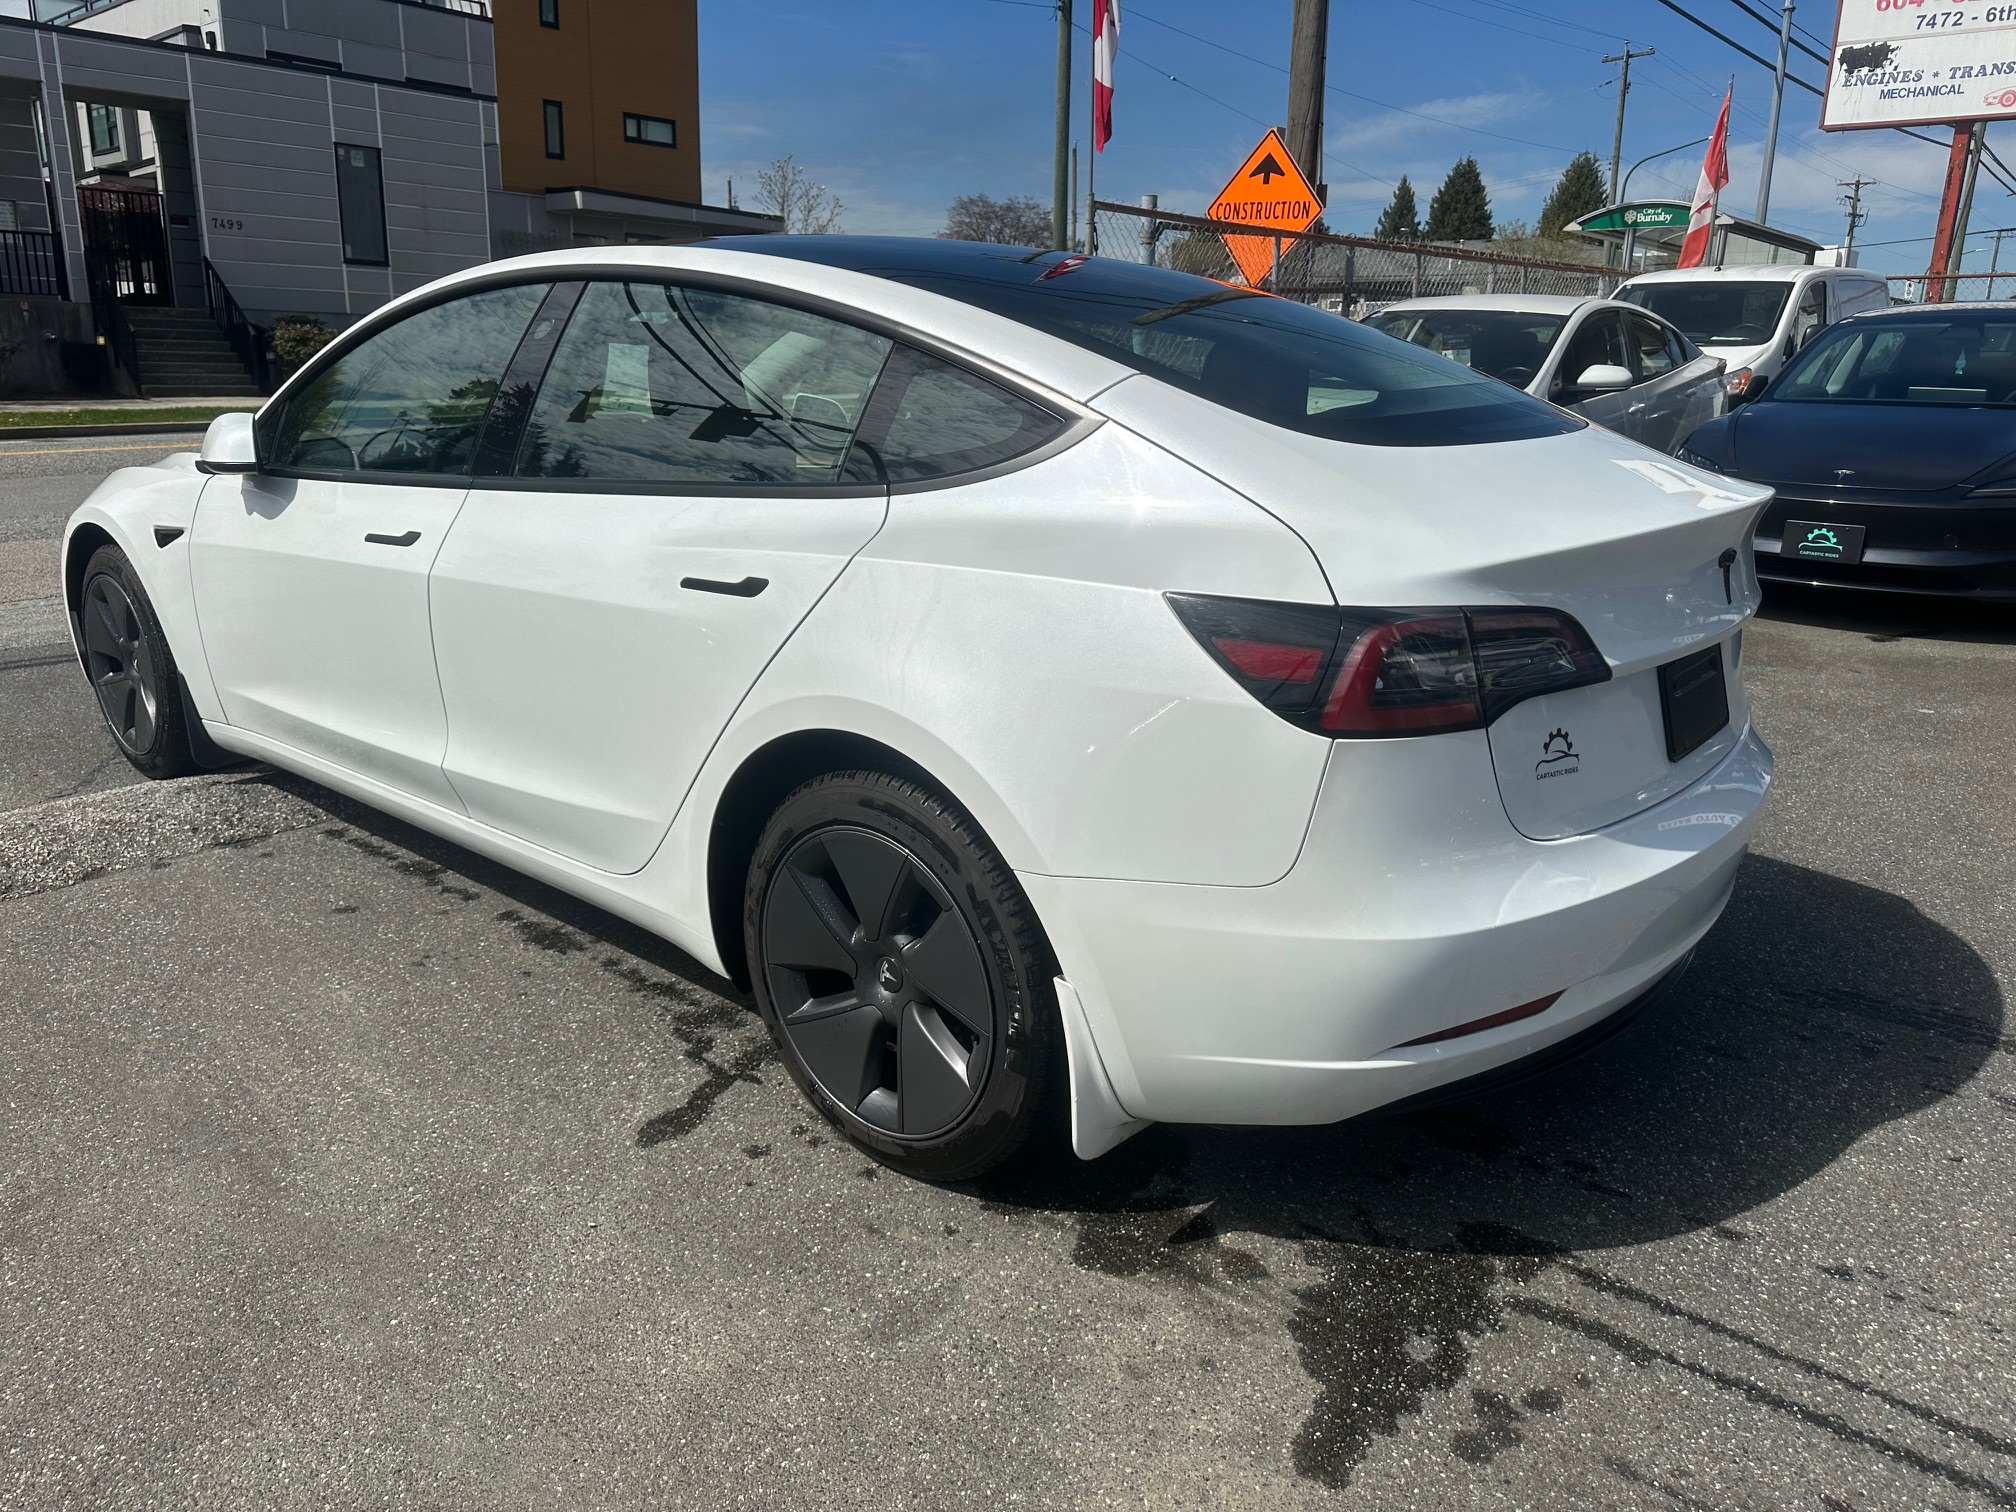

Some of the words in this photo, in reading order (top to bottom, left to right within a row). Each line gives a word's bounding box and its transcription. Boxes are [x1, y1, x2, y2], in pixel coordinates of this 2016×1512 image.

[1916, 11, 1964, 30] 7472
[1985, 5, 2016, 23] 6th
[1842, 69, 1925, 88] ENGINES
[1879, 84, 1965, 100] MECHANICAL
[1216, 201, 1311, 221] CONSTRUCTION
[1636, 212, 1673, 224] Burnaby
[211, 217, 243, 231] 7499
[1536, 769, 1564, 780] CARTASTIC
[1564, 766, 1579, 775] RIDES
